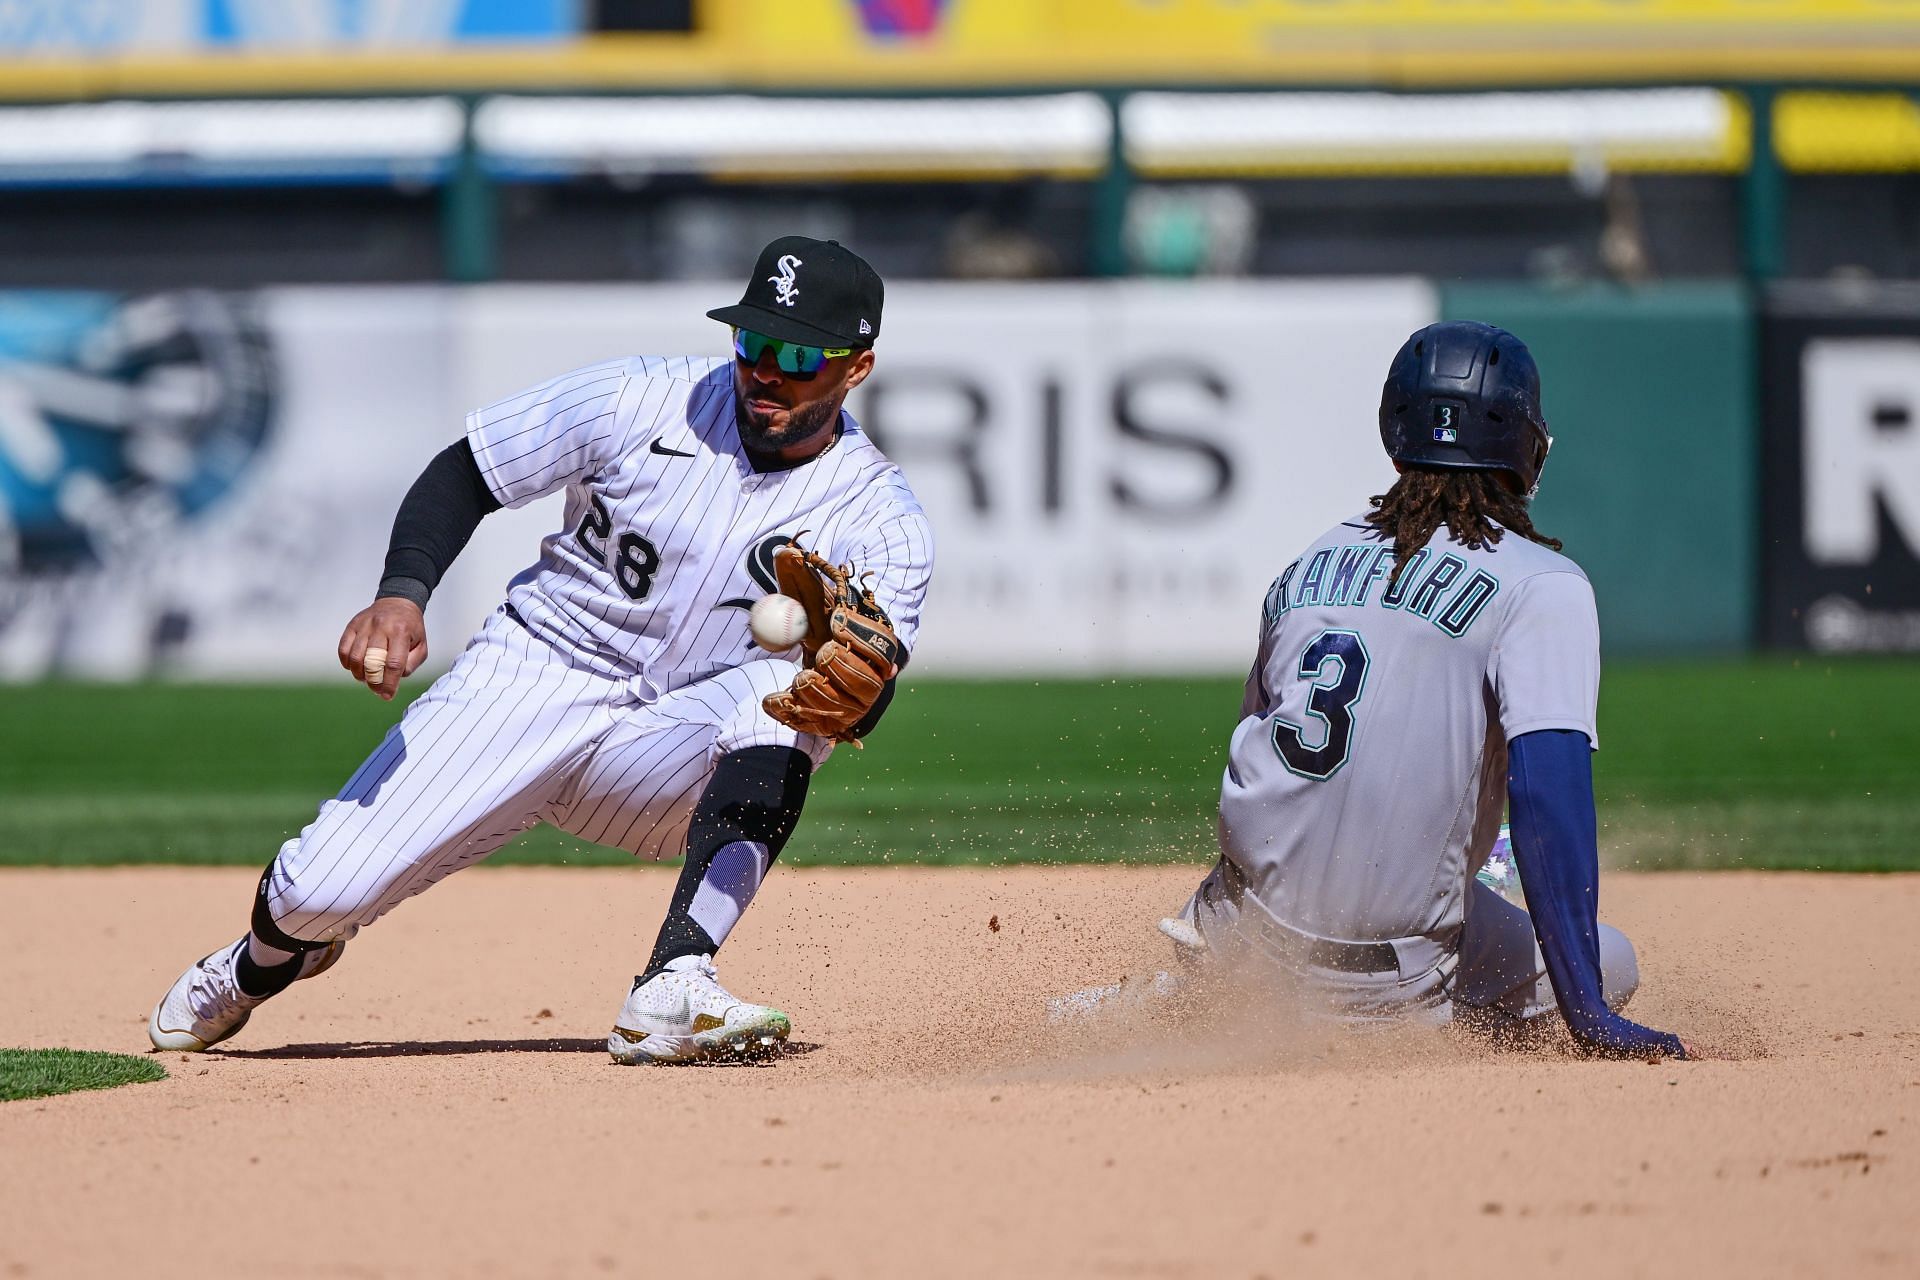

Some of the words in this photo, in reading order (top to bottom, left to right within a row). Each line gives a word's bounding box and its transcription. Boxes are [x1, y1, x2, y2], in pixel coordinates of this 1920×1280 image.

[1441, 407, 1452, 427] 3
[575, 490, 662, 604] 28
[1271, 628, 1371, 782] 3
